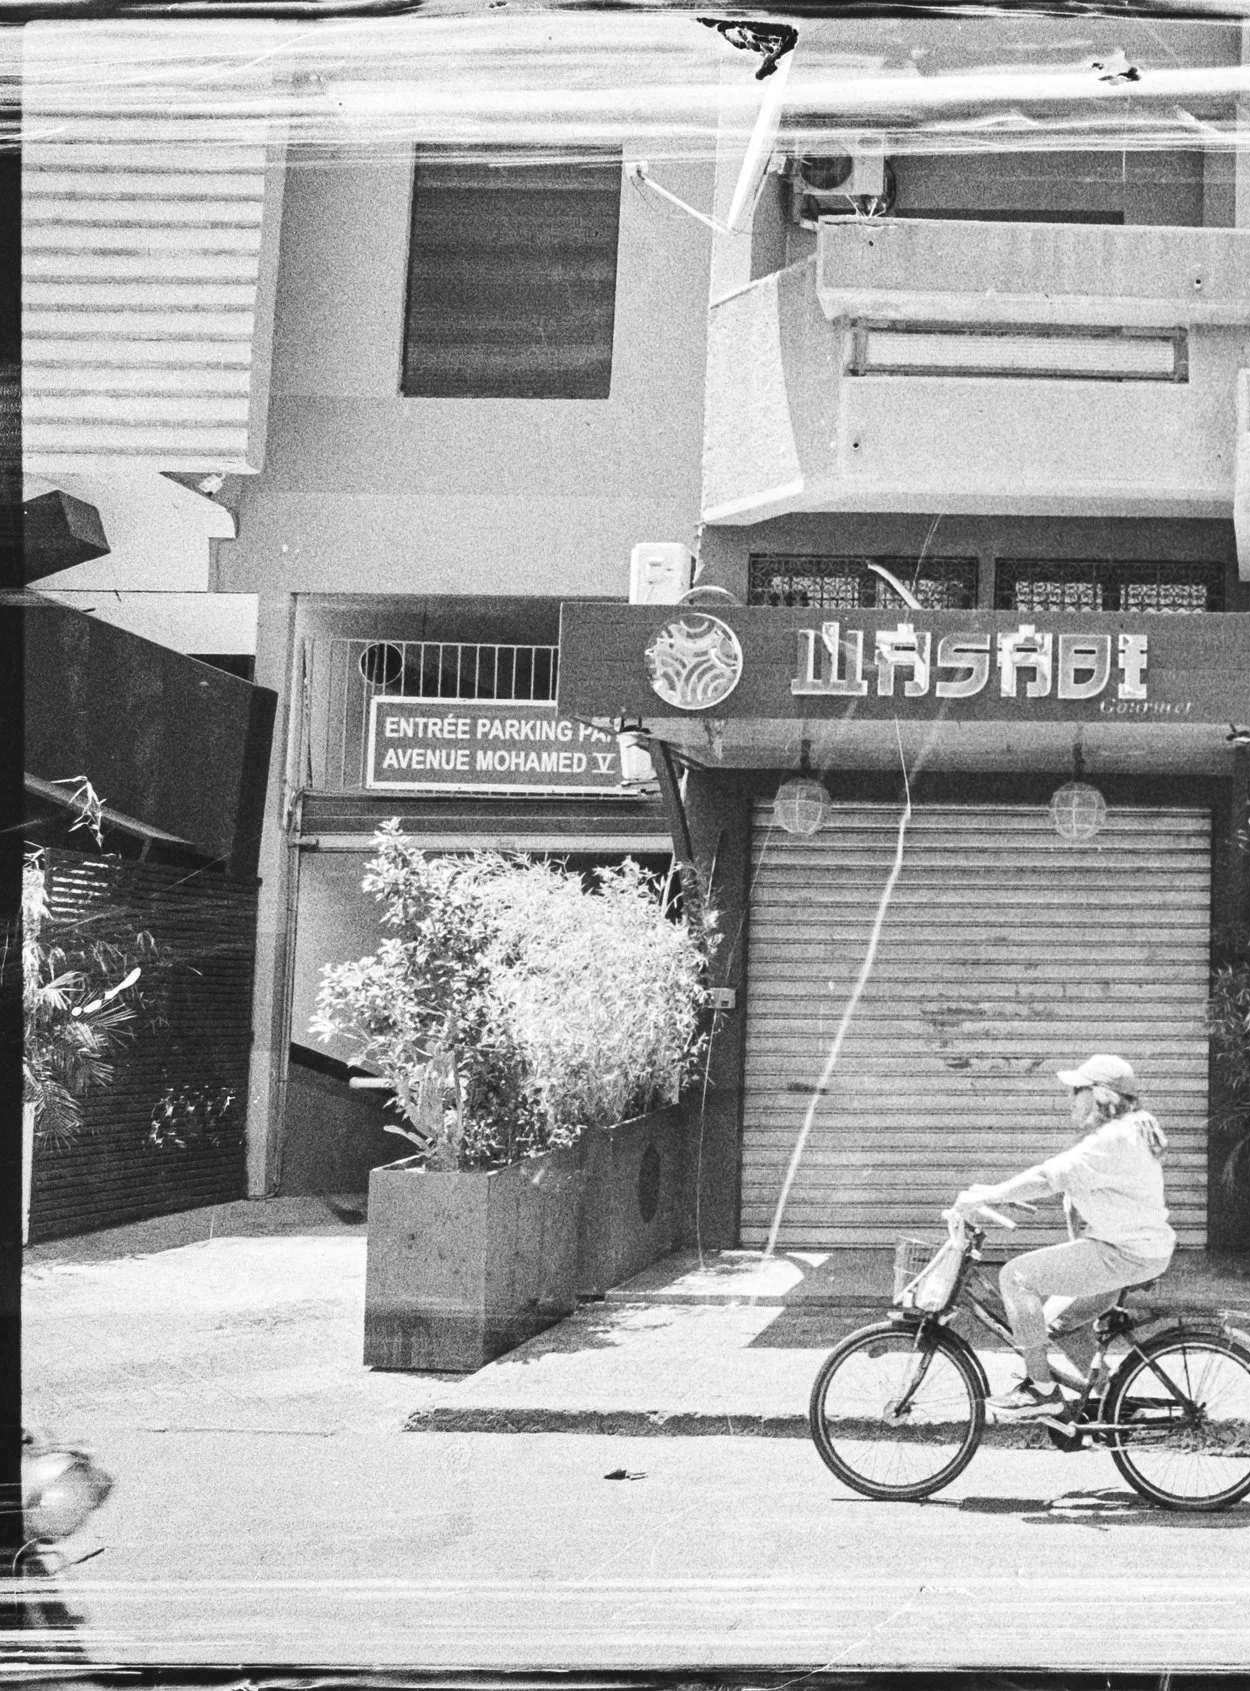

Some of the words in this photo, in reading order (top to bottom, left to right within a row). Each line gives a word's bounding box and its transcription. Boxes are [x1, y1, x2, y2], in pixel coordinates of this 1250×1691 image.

[792, 622, 1148, 699] WASABI
[1100, 698, 1193, 714] Gourmet
[385, 714, 471, 739] ENTRÉE
[477, 718, 573, 742] PARKING
[382, 748, 469, 771] AVENUE
[476, 751, 587, 773] MOHAMED
[592, 752, 616, 773] V
